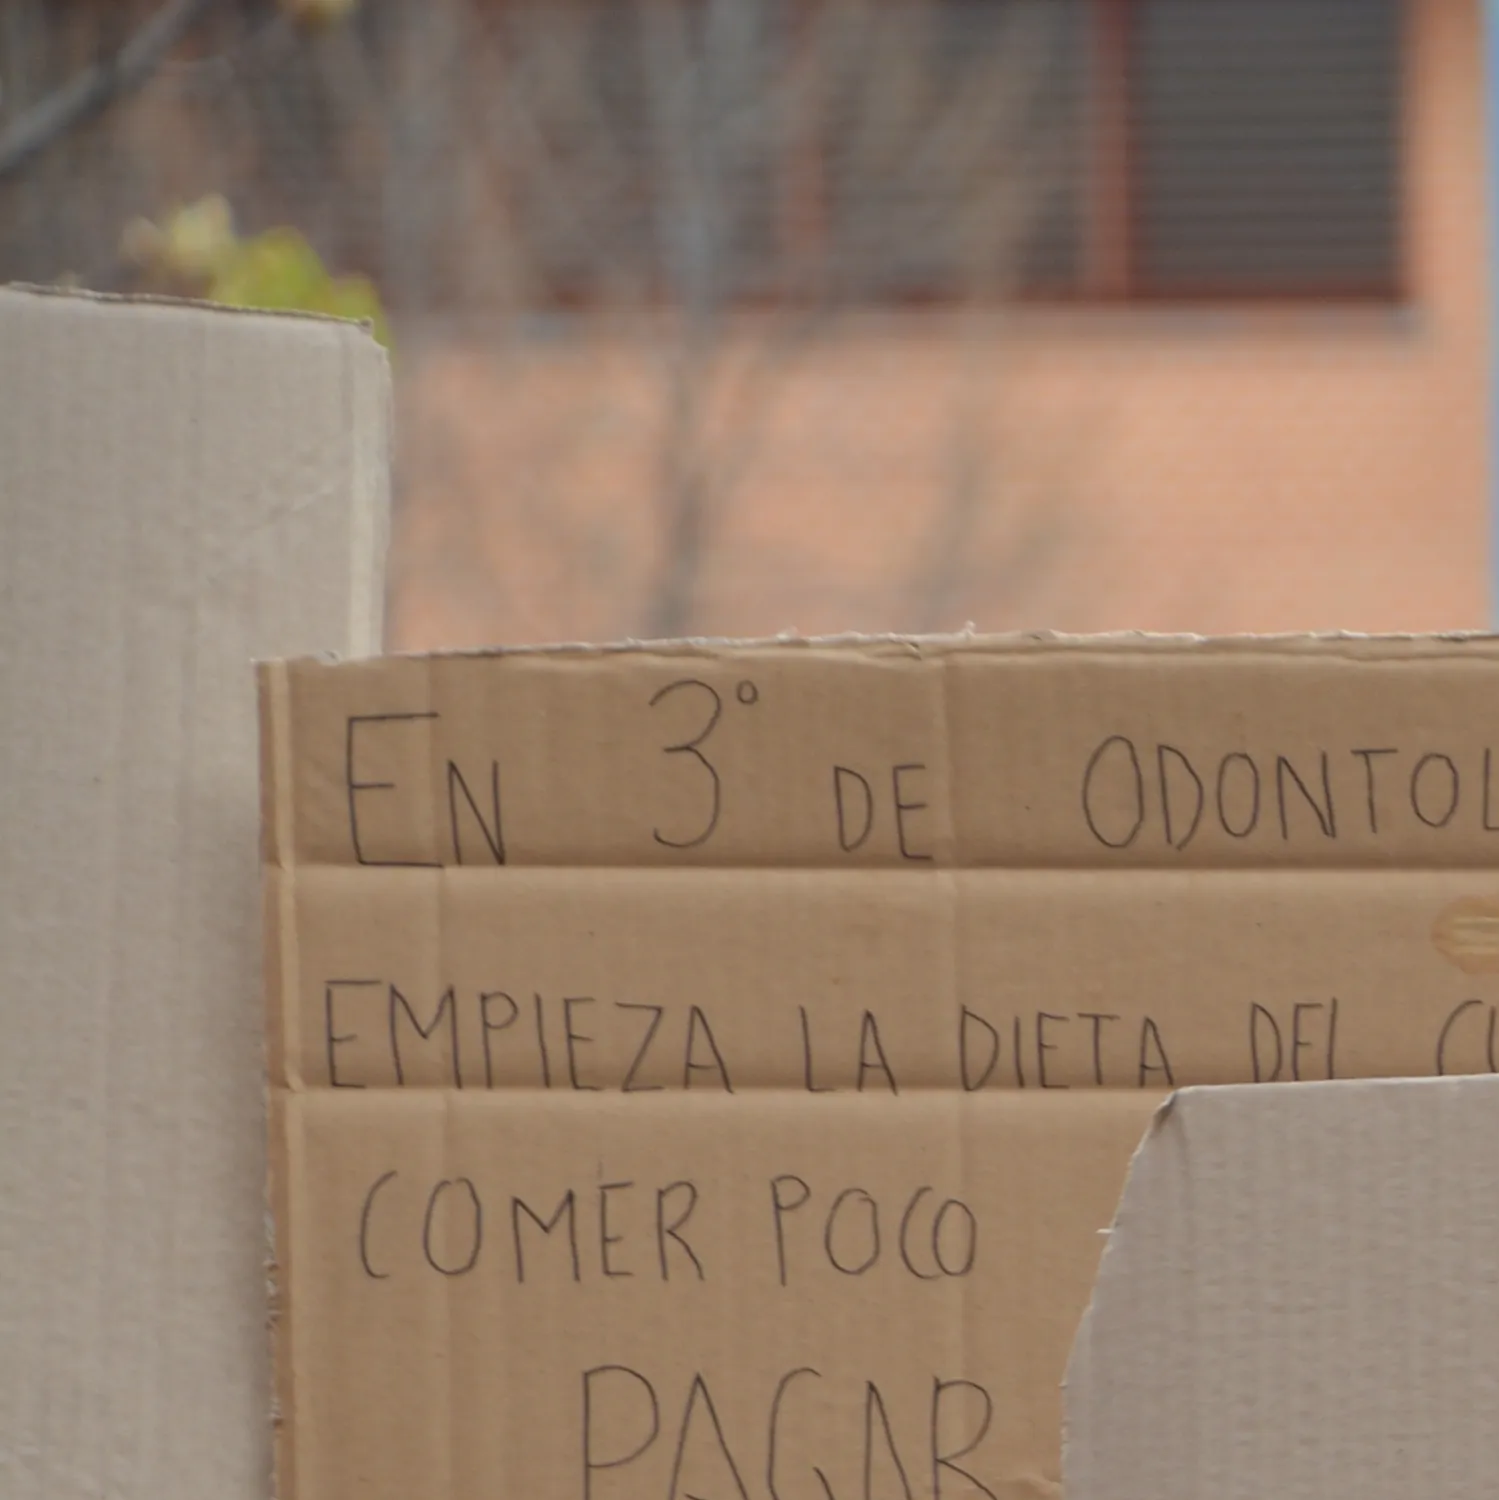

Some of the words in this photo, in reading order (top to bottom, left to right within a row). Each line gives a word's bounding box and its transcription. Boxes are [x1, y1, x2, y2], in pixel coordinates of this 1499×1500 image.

[346, 710, 508, 868] EN
[833, 762, 935, 862] DE
[324, 978, 736, 1094] EMPIEZA
[798, 1003, 900, 1097] LA
[959, 1003, 1176, 1091] DIETA
[359, 1169, 705, 1284] COMER
[769, 1173, 977, 1287] POCO
